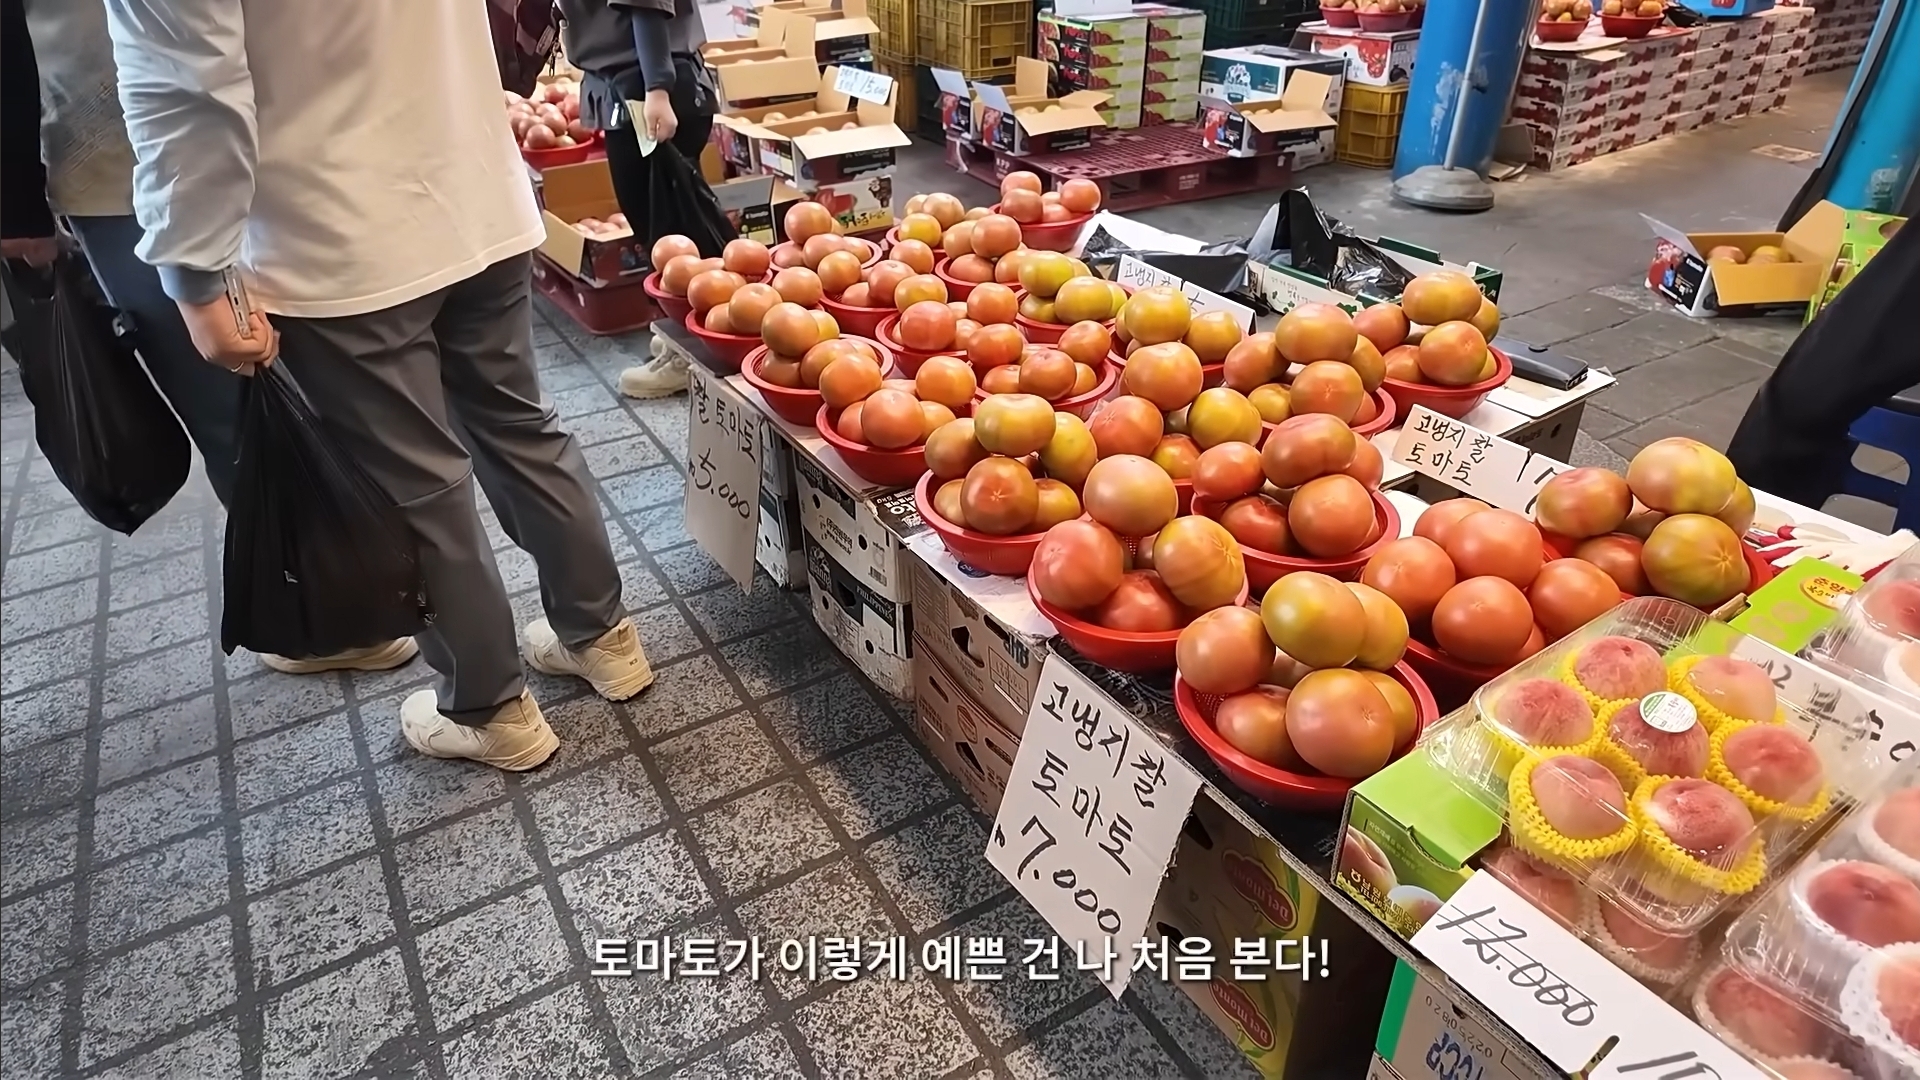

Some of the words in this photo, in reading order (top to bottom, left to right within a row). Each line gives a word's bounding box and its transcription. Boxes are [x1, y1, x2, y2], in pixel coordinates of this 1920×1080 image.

[1124, 262, 1156, 287] 고냉지
[692, 374, 710, 425] 찰
[716, 397, 757, 464] 토마토
[1413, 414, 1466, 449] 고냉지
[1470, 433, 1494, 464] 찰
[1405, 441, 1472, 487] 토마토
[1031, 750, 1134, 876] 토마토
